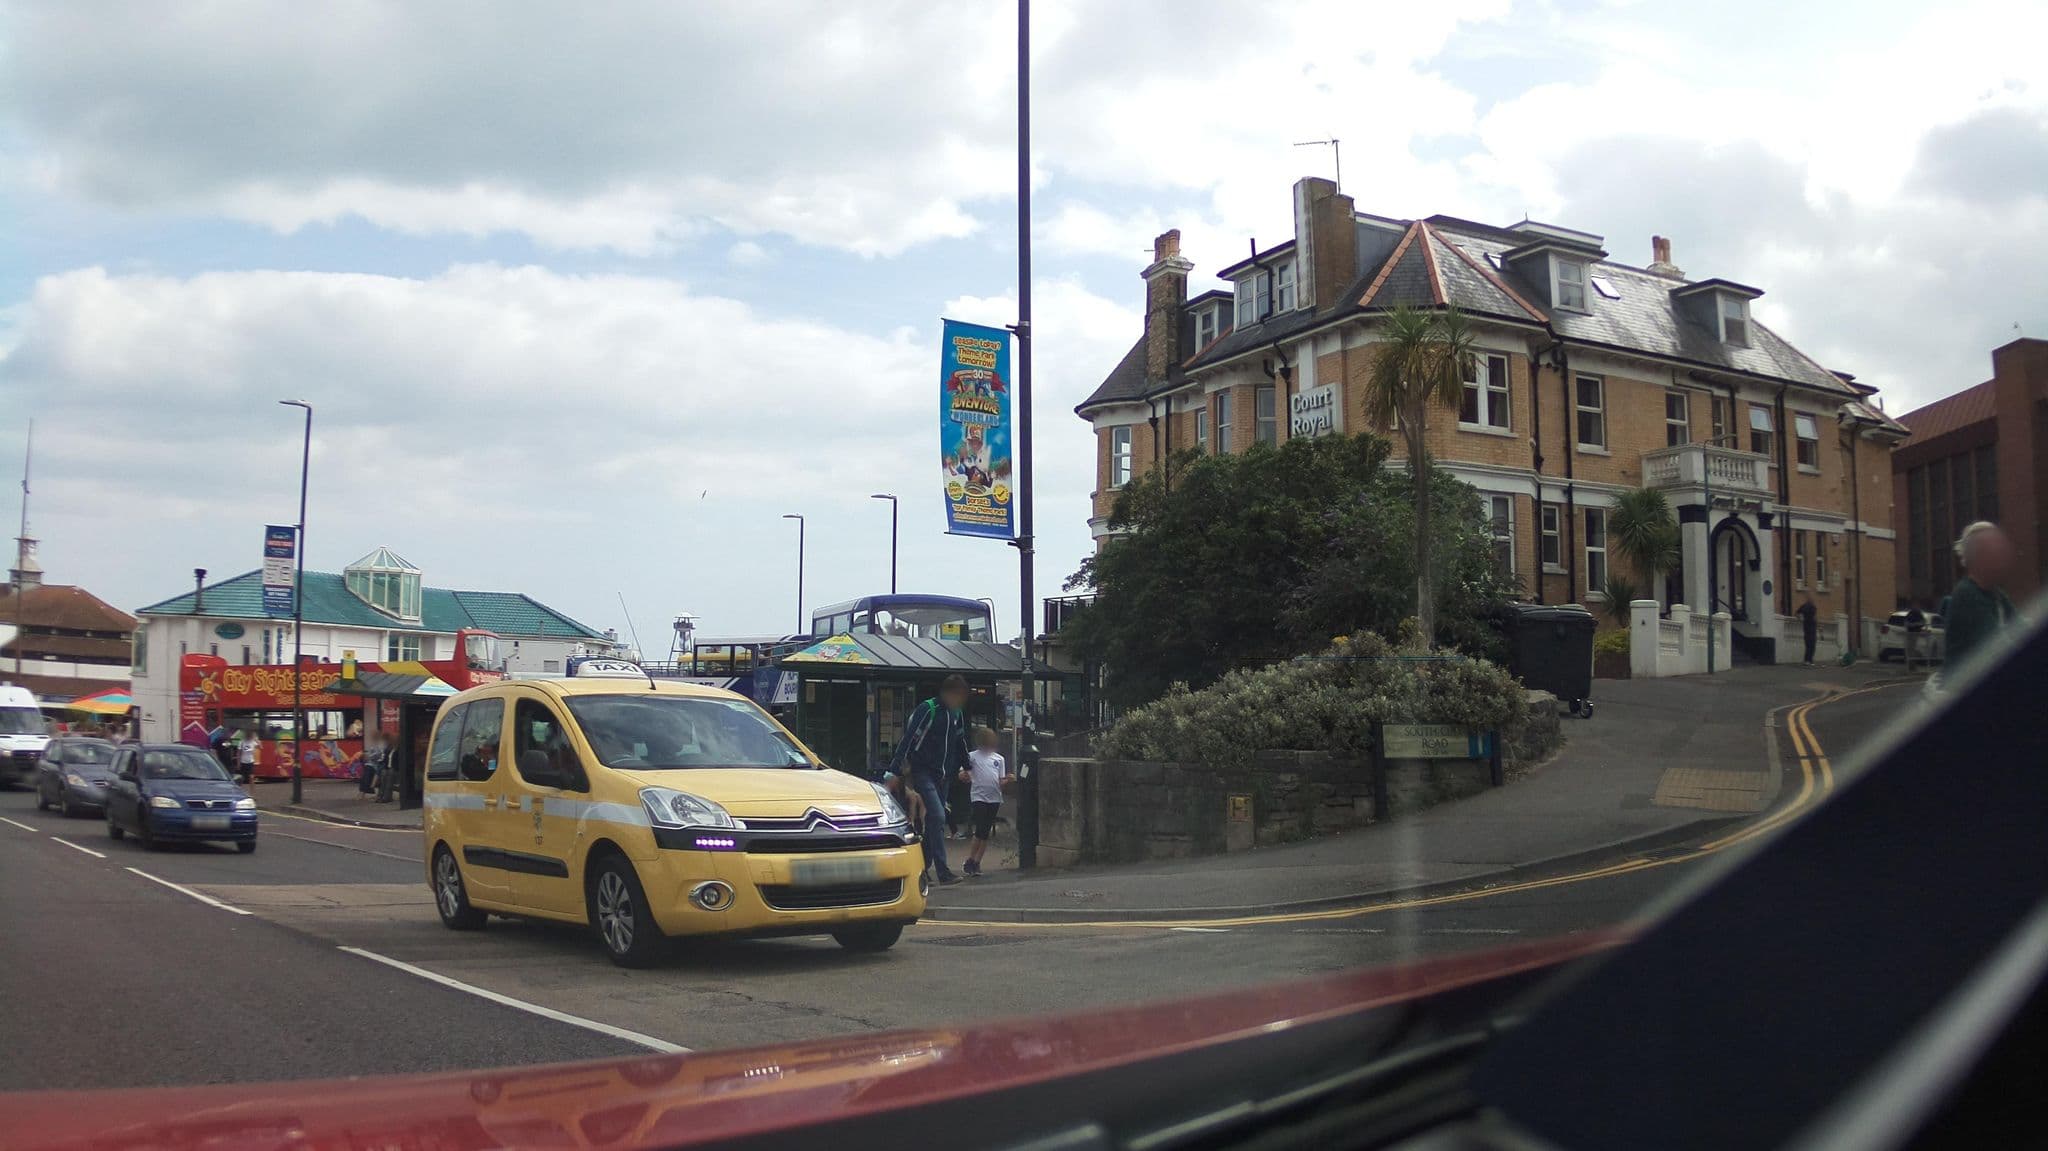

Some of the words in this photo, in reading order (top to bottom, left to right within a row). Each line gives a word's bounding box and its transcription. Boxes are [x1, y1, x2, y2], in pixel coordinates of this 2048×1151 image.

[973, 369, 984, 379] 30
[951, 398, 1000, 414] ADVENTURE
[1293, 387, 1332, 413] Court
[1293, 408, 1331, 436] Royal
[589, 663, 640, 673] TAXI
[224, 668, 250, 694] City
[1422, 738, 1449, 749] ROAD
